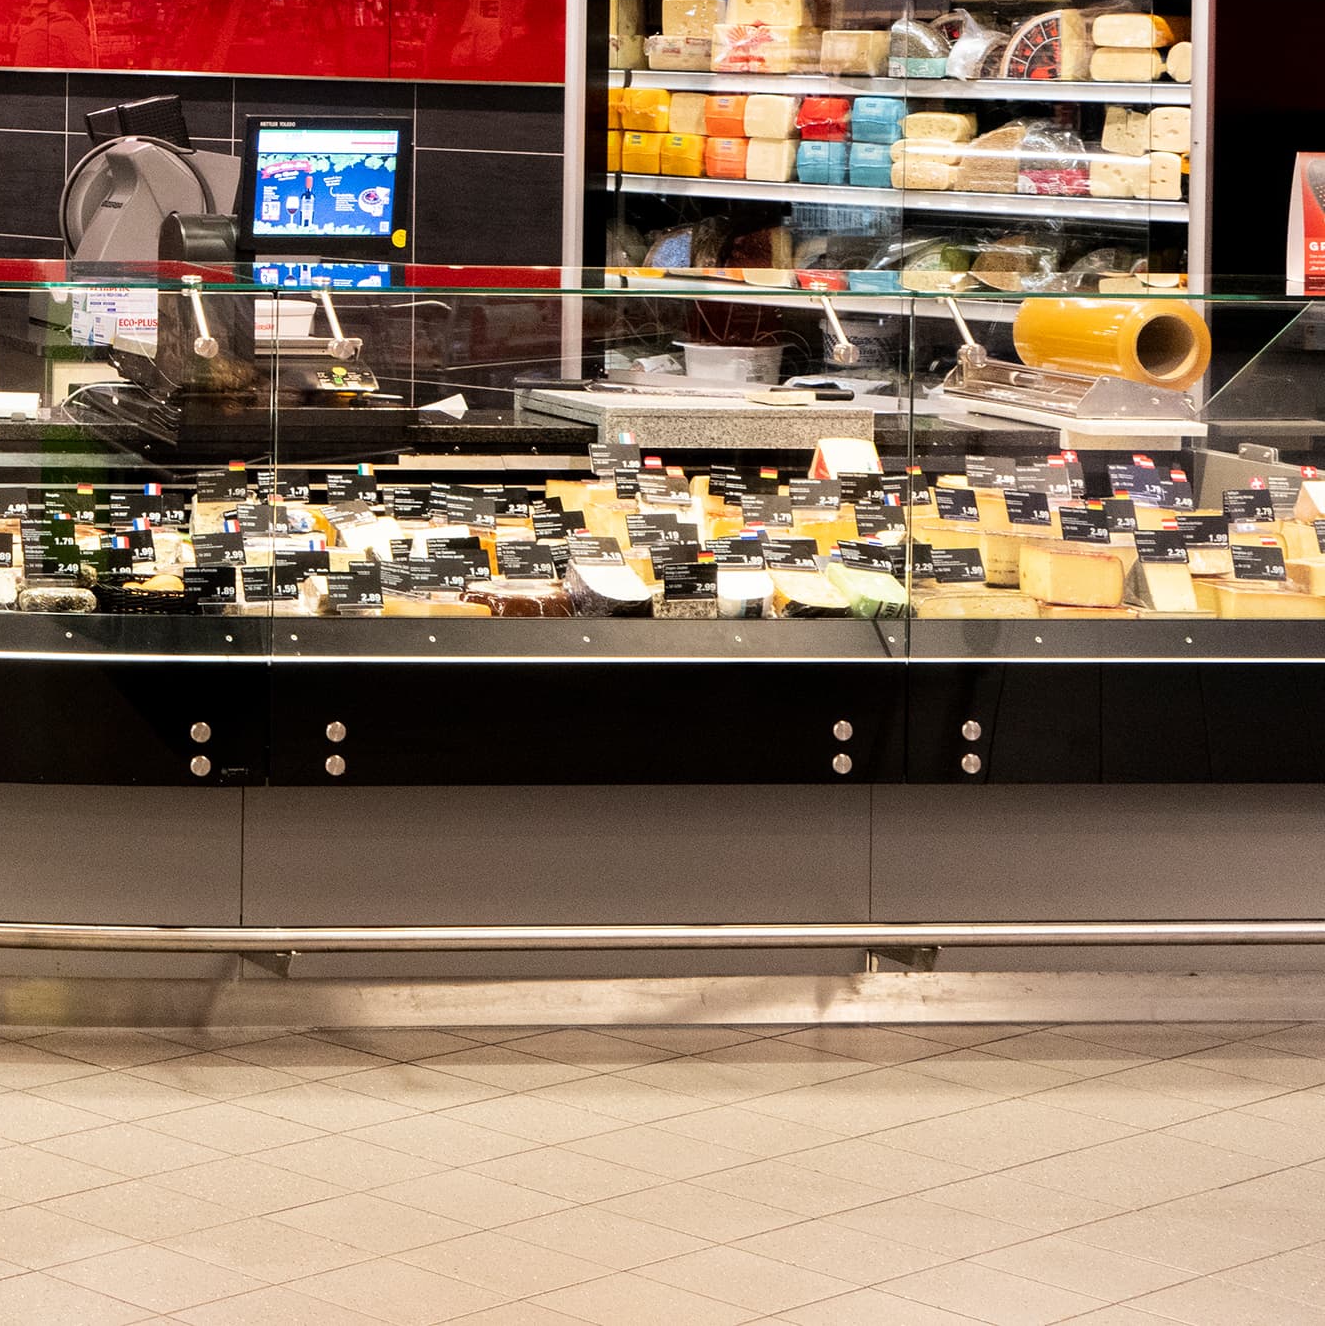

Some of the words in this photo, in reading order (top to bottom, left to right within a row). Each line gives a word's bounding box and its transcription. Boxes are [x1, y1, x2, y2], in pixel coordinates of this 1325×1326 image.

[118, 319, 158, 327] ECO-PLUS
[660, 531, 680, 541] 1.19
[58, 563, 79, 573] 2.49
[216, 586, 235, 596] 1.89
[277, 584, 297, 594] 1.59
[697, 582, 716, 592] 2.99
